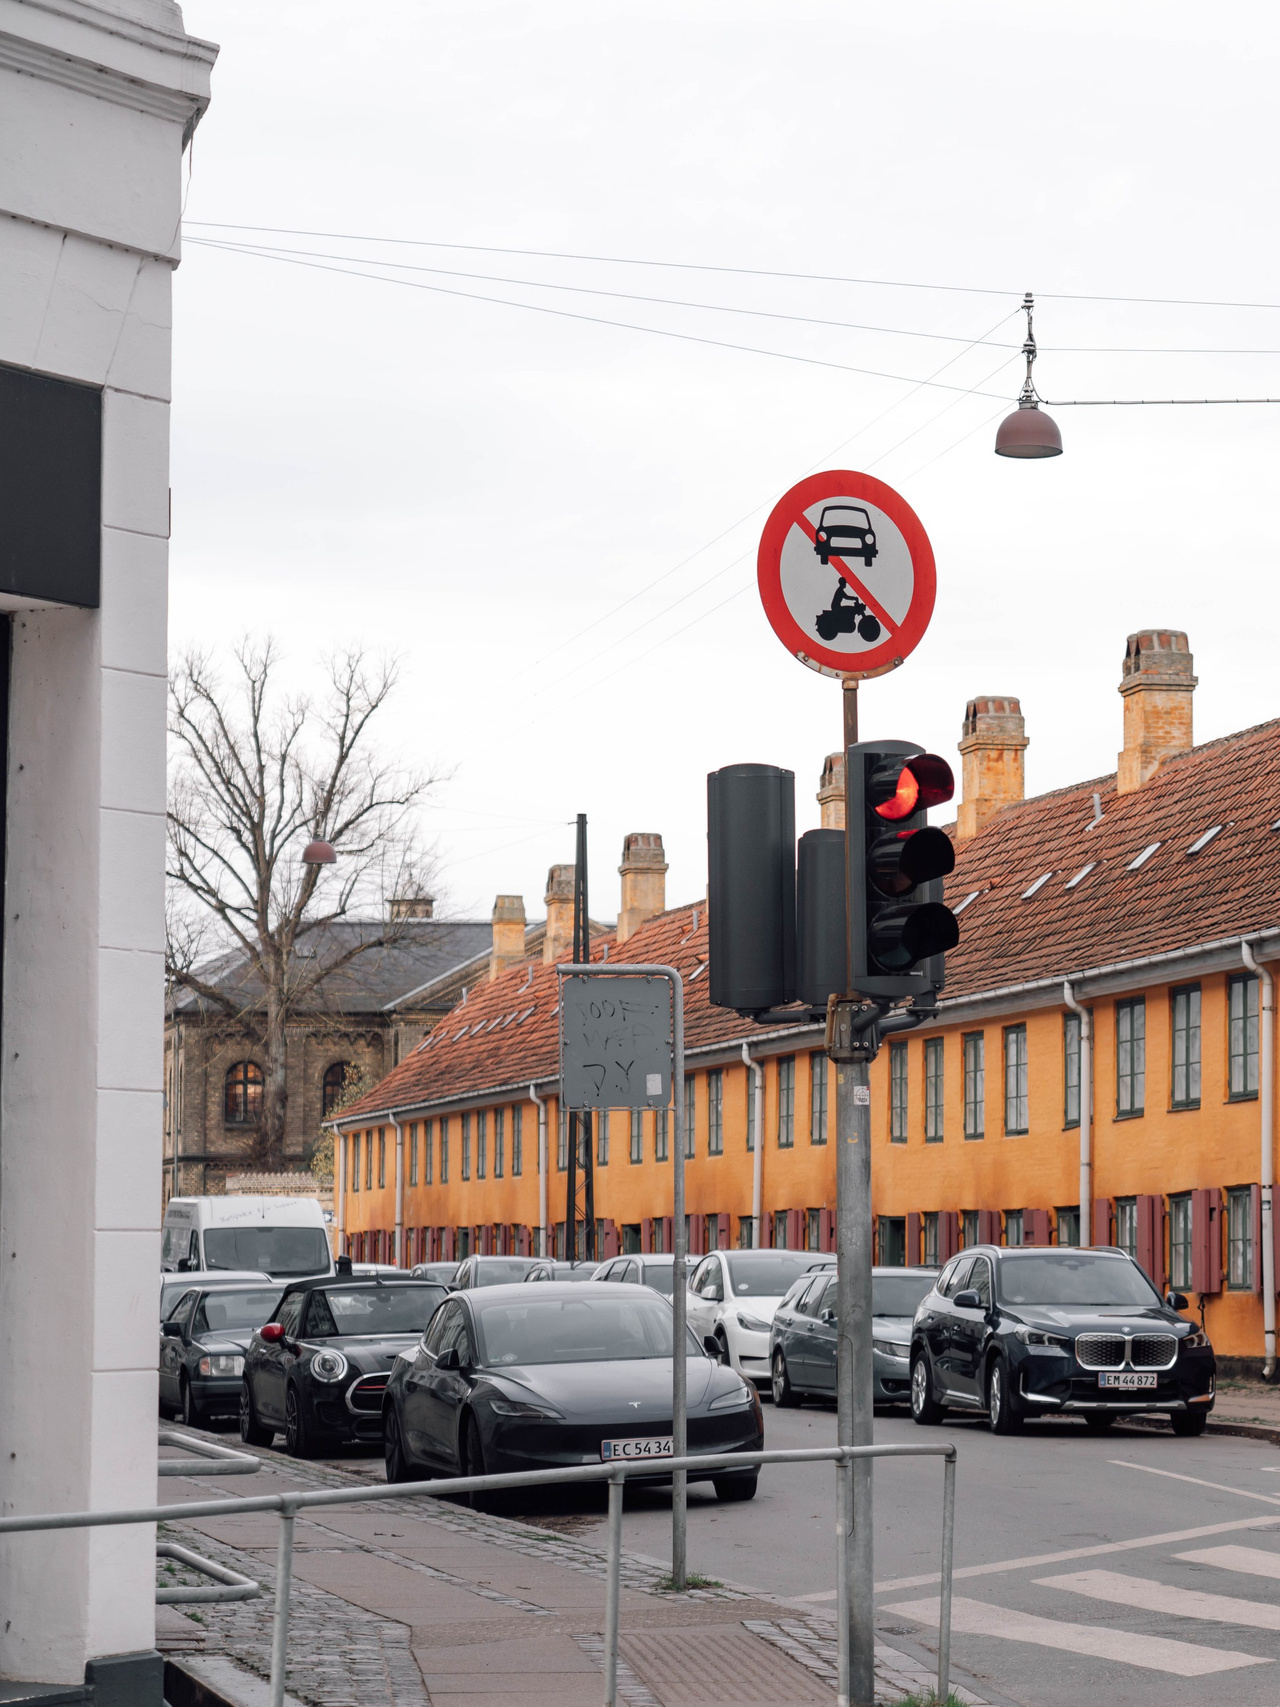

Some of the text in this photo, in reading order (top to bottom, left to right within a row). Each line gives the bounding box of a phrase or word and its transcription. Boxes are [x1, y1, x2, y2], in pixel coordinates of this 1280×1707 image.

[1107, 1375, 1120, 1385] EM
[1122, 1375, 1135, 1385] 44
[1136, 1375, 1156, 1386] 872
[613, 1440, 673, 1457] EC 54 34
